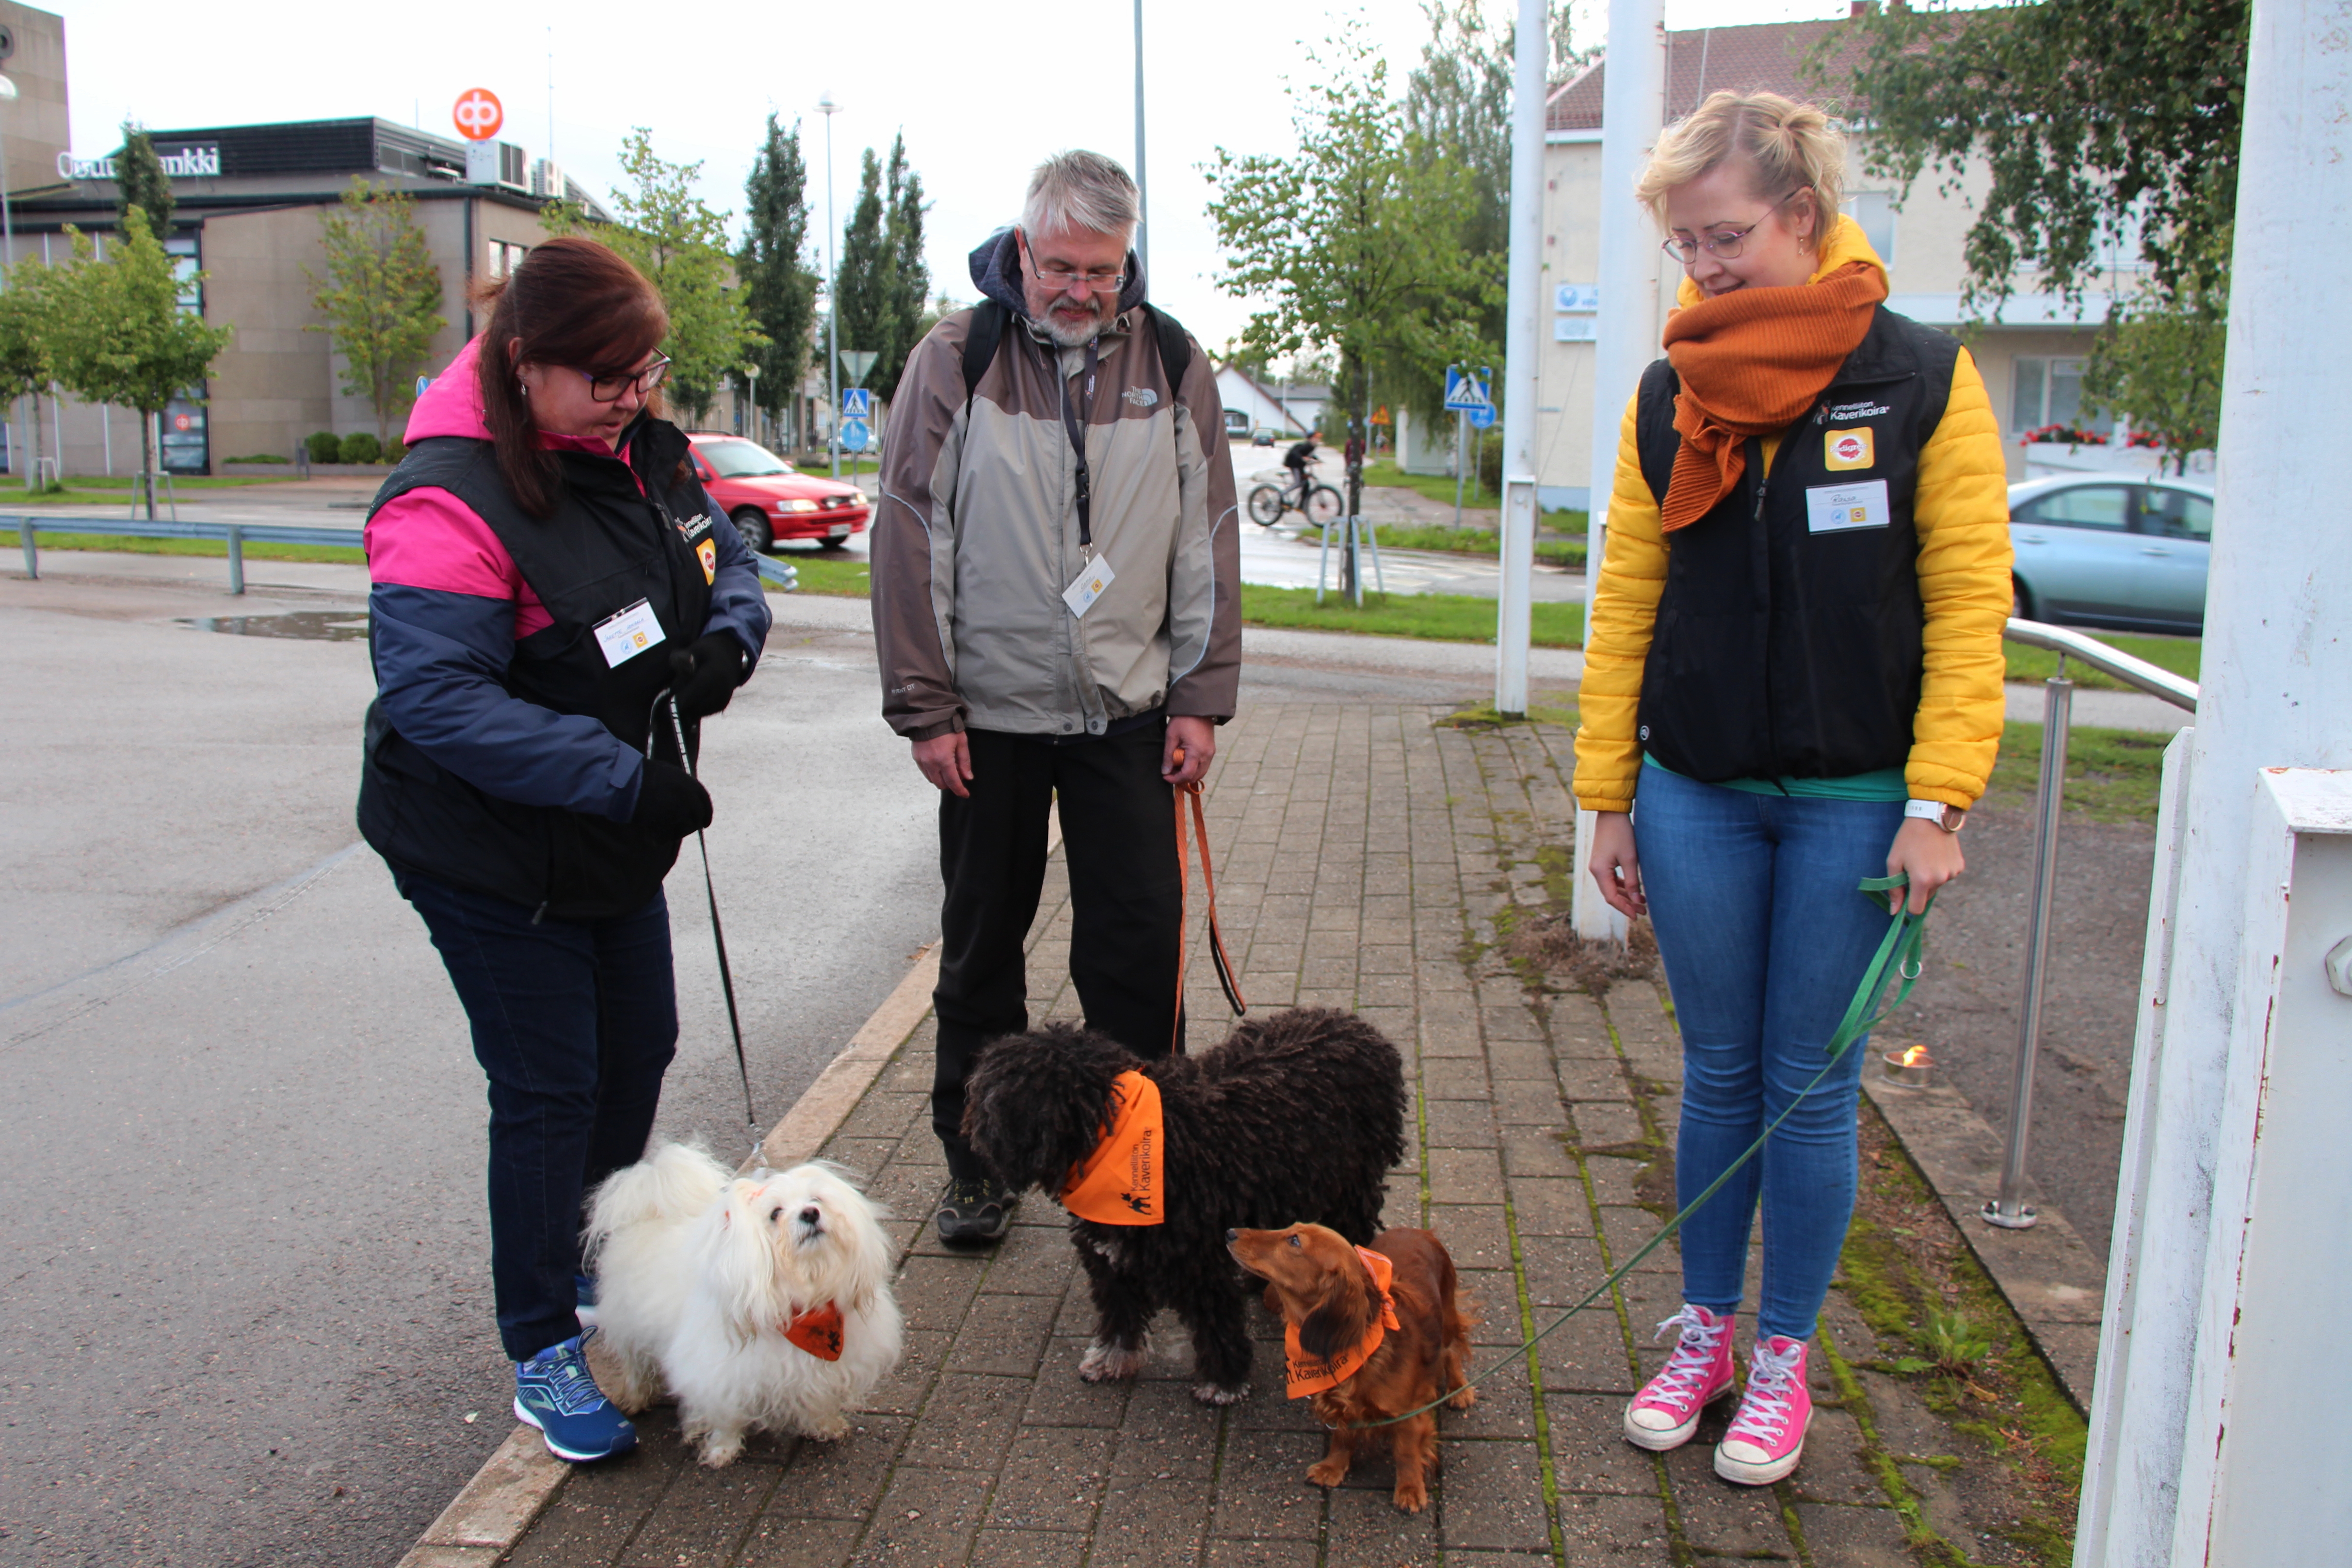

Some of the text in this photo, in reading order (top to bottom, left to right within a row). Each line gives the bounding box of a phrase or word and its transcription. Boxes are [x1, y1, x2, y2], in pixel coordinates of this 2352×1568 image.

[1131, 386, 1142, 394] THE
[1122, 391, 1143, 400] NORTH
[1129, 398, 1144, 406] FACE
[1830, 443, 1867, 453] Pedigree
[1130, 1144, 1139, 1192] Kennelliiton
